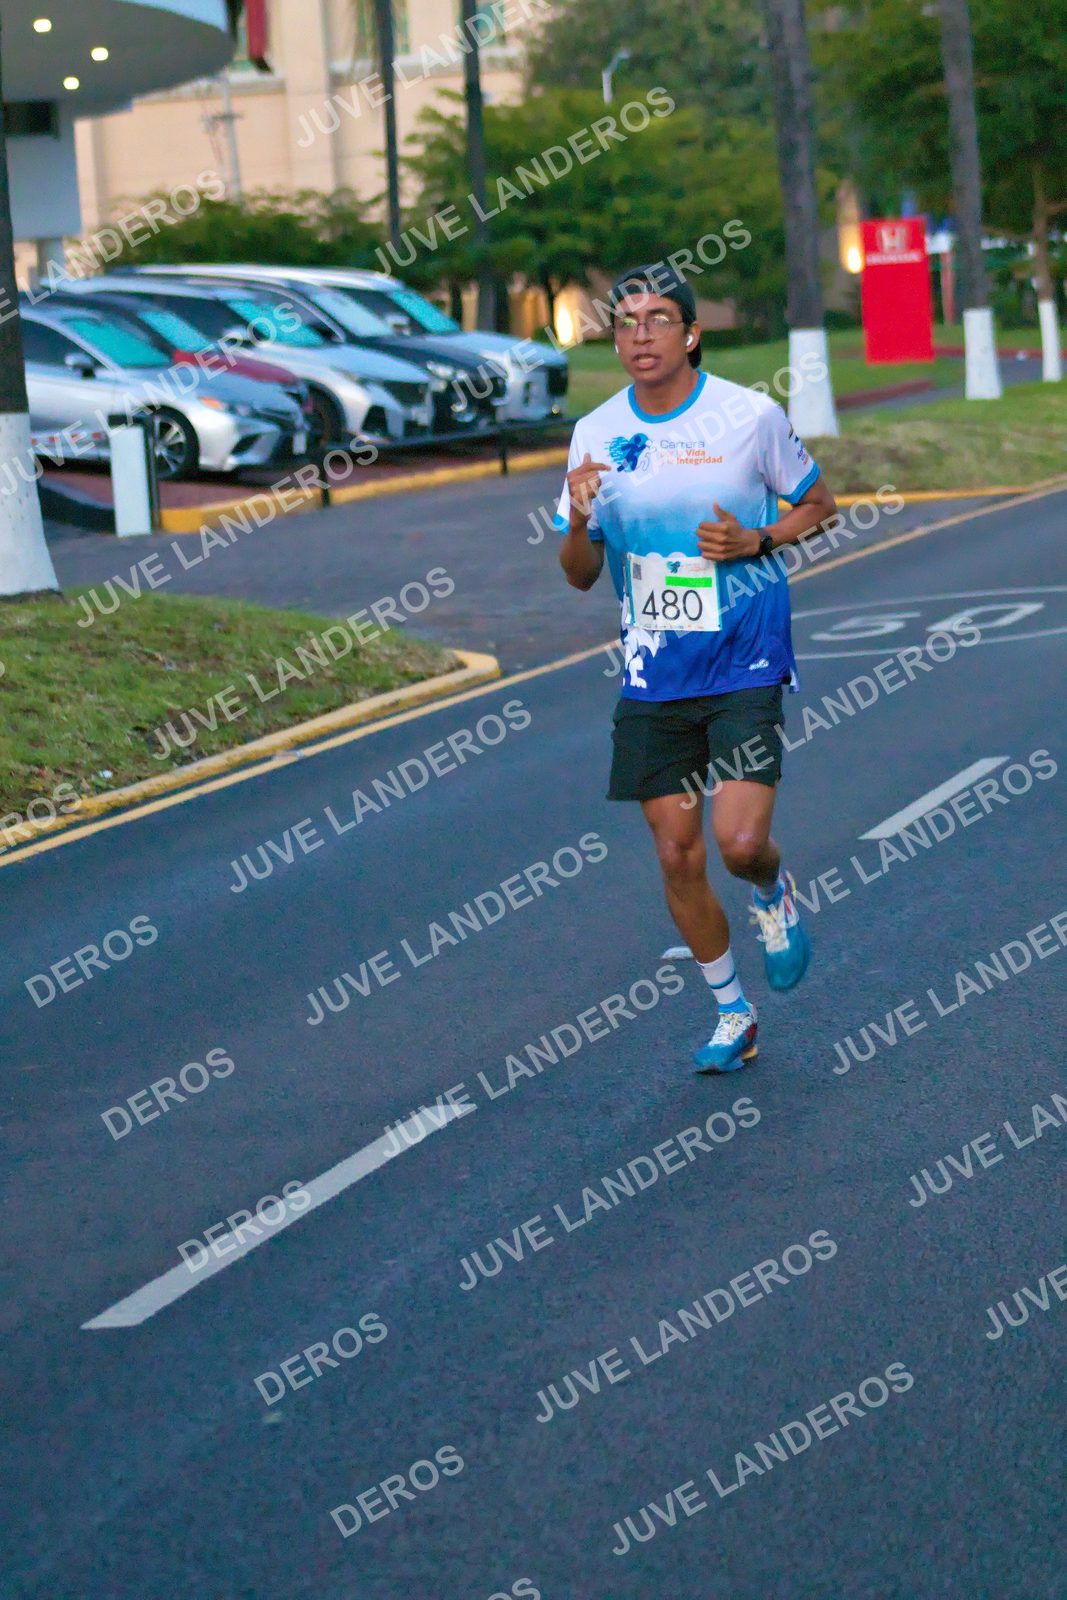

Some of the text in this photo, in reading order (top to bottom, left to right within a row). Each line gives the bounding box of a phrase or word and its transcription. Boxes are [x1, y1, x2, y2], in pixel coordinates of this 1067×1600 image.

[660, 440, 705, 449] Carrera
[686, 449, 706, 457] Vida
[676, 455, 723, 466] Integridad
[642, 589, 703, 621] 480
[810, 602, 1045, 642] 50
